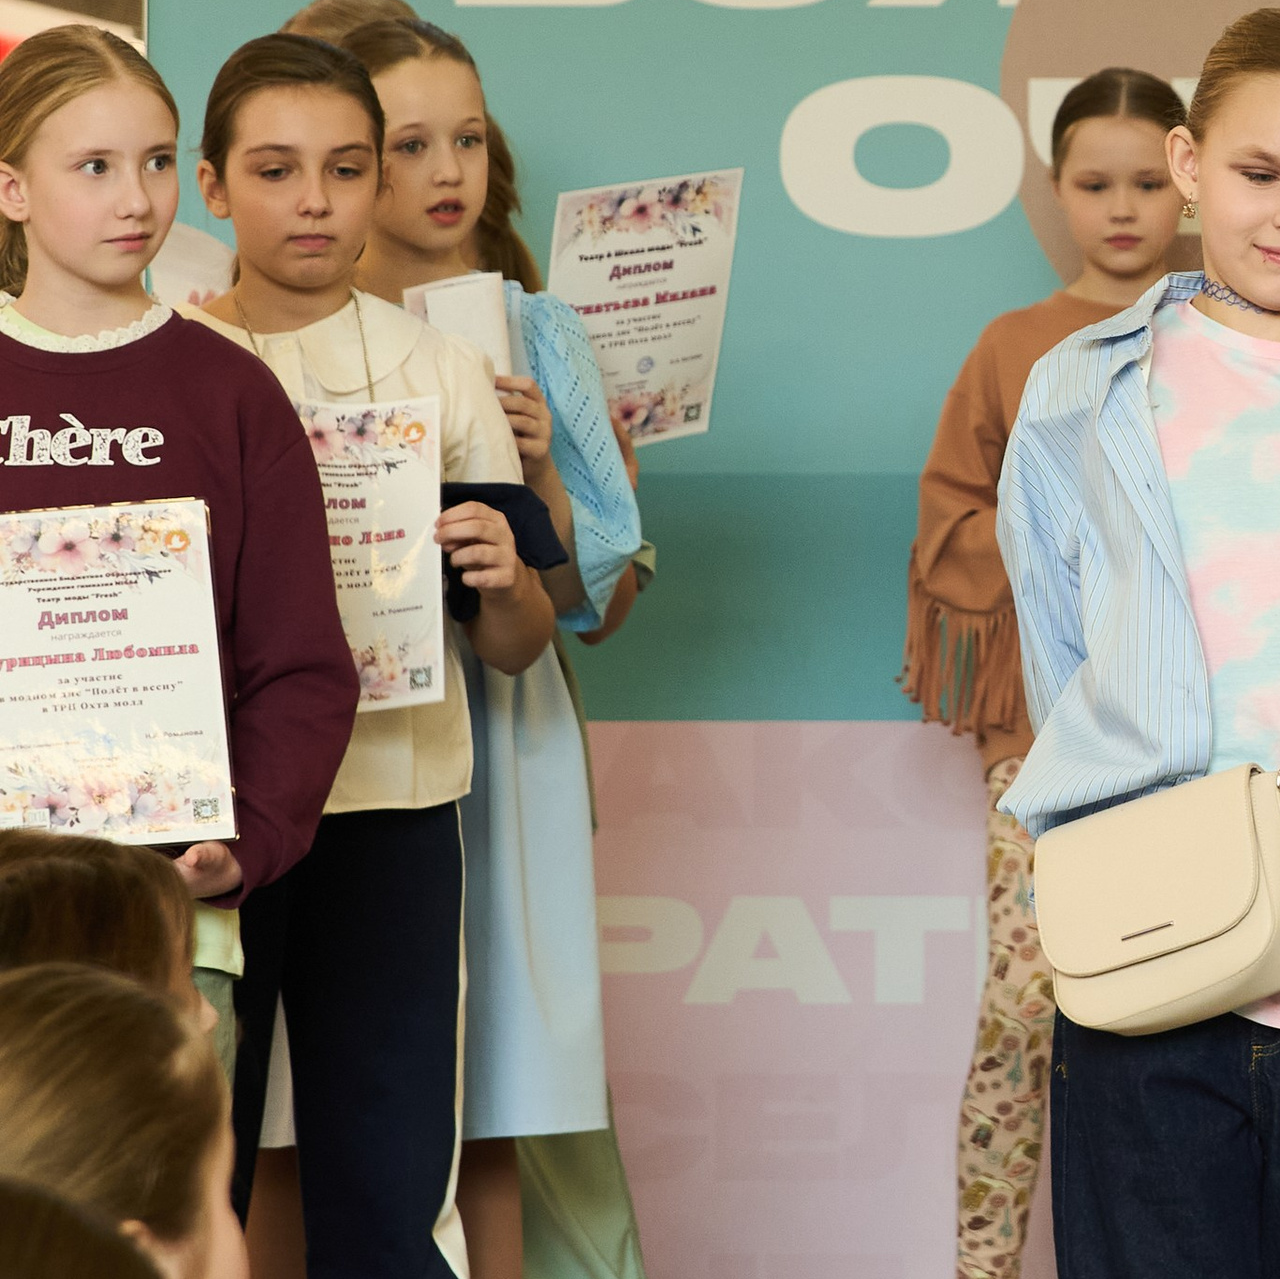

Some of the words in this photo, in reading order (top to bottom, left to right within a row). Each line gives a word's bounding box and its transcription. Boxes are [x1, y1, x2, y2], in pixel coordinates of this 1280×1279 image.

[609, 259, 674, 281] Диплом
[38, 608, 128, 630] Диплом
[51, 629, 122, 642] награждается
[91, 644, 199, 662] Любомила
[80, 701, 110, 711] Охта
